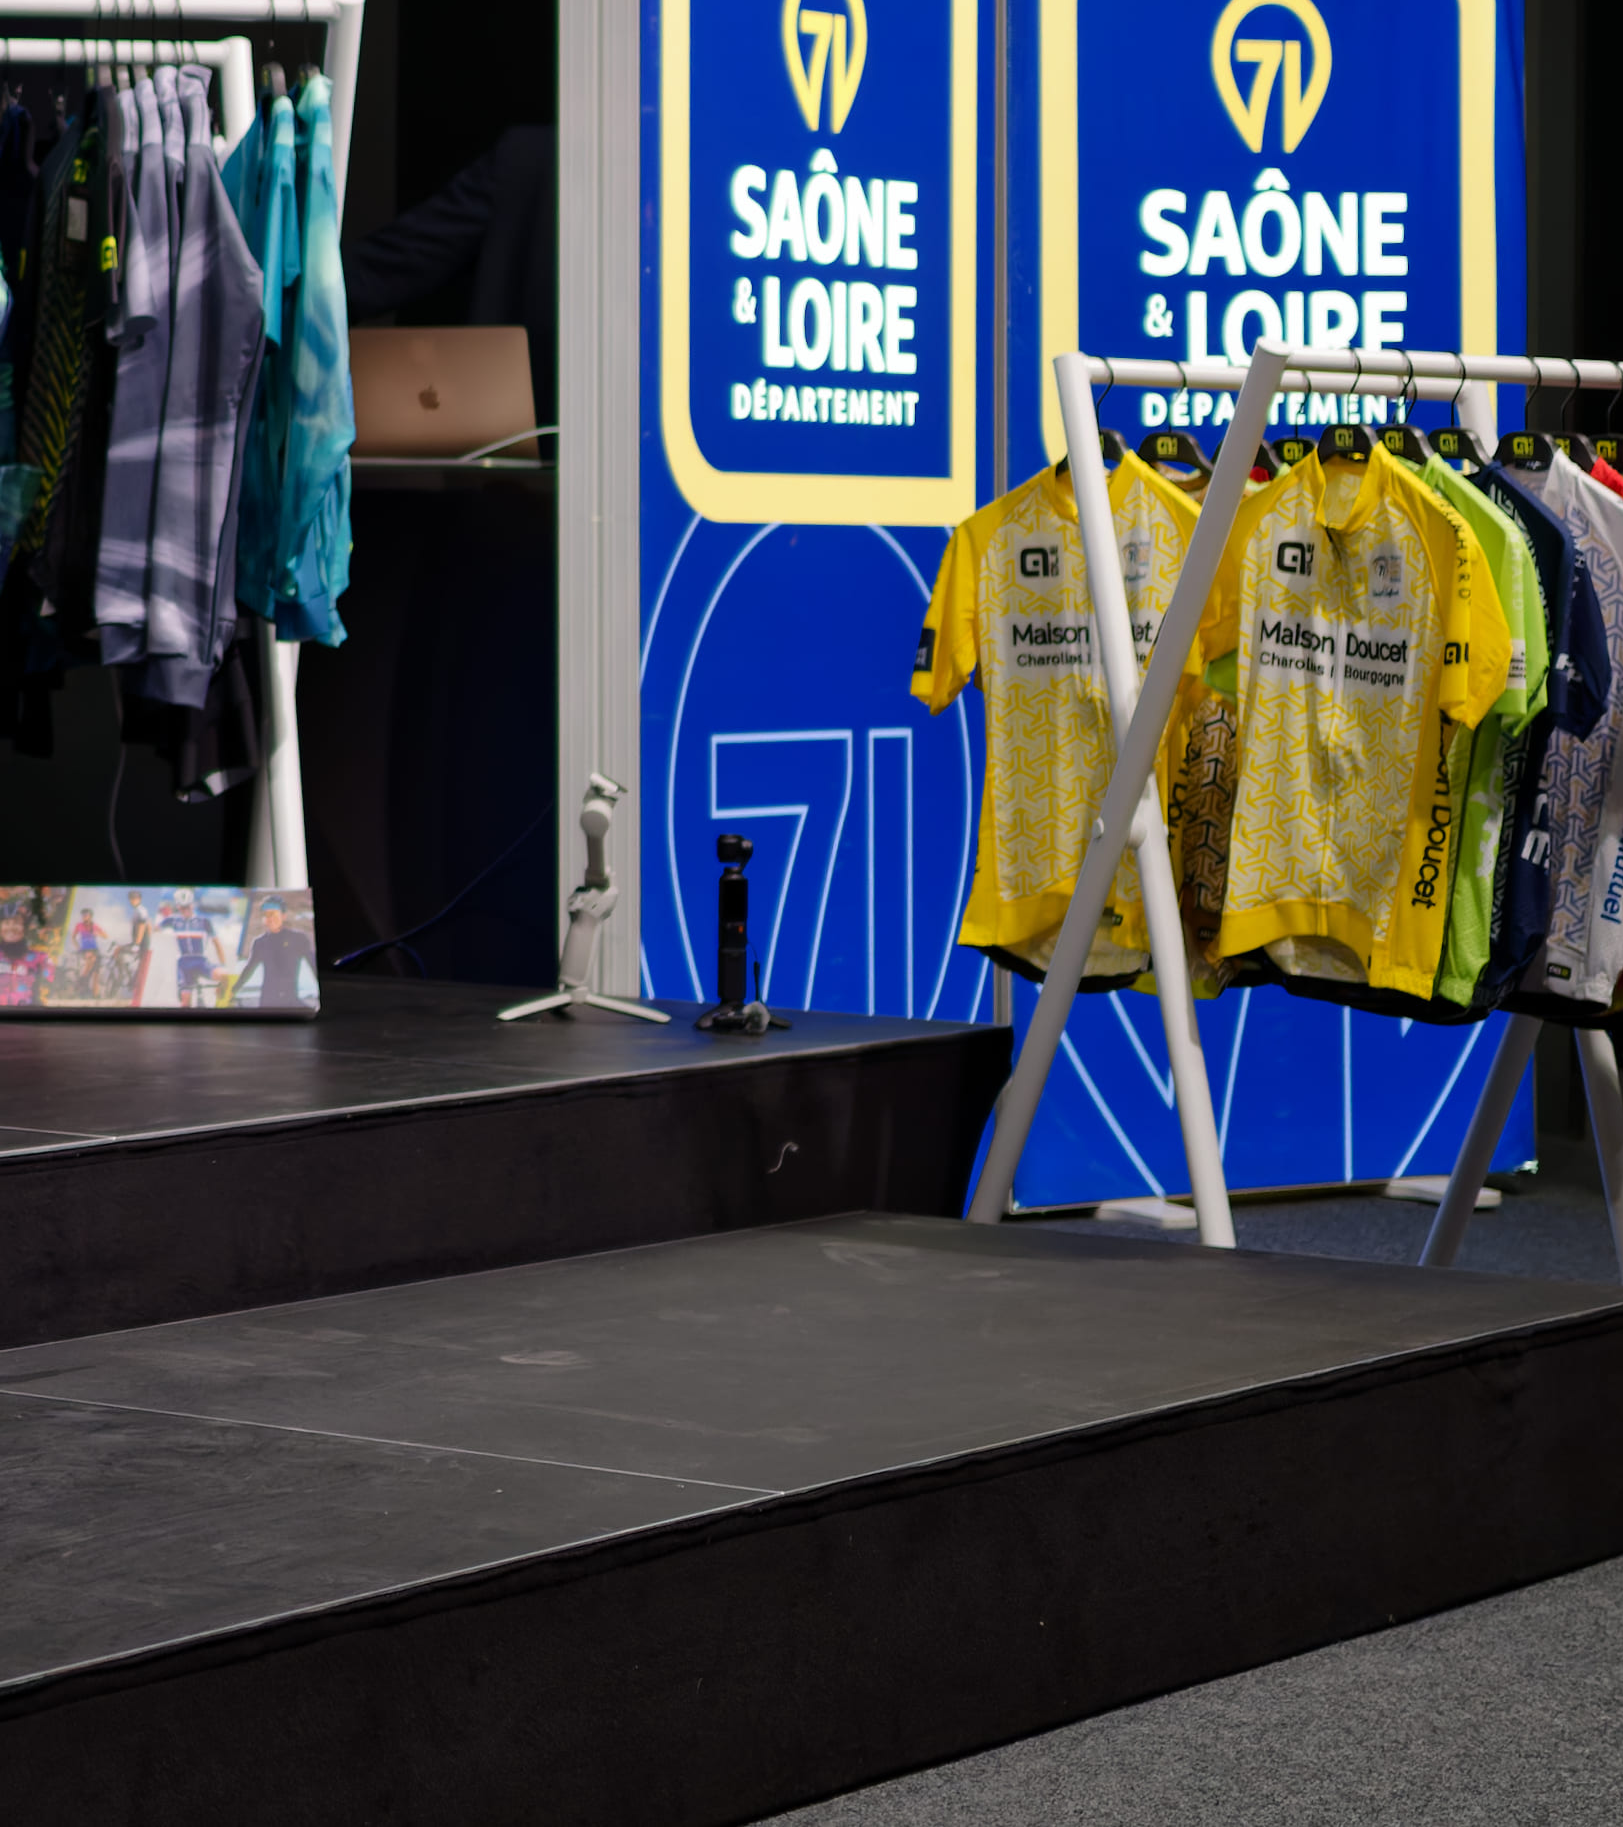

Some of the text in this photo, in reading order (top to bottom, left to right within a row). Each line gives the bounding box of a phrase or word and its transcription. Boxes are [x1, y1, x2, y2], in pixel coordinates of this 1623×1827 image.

[729, 148, 920, 271] SAÔNE
[1139, 168, 1409, 278] SAÔNE
[731, 276, 919, 376] & LOIRE
[1143, 293, 1176, 338] &
[730, 379, 921, 428] DÉPARTEMENT
[1141, 390, 1410, 428] DÉPATEMENT
[1012, 621, 1090, 647] Maison
[1259, 619, 1336, 656] Maison
[1345, 632, 1408, 664] Doucet
[1343, 664, 1405, 688] Bourgogne
[1411, 804, 1452, 910] Doucet
